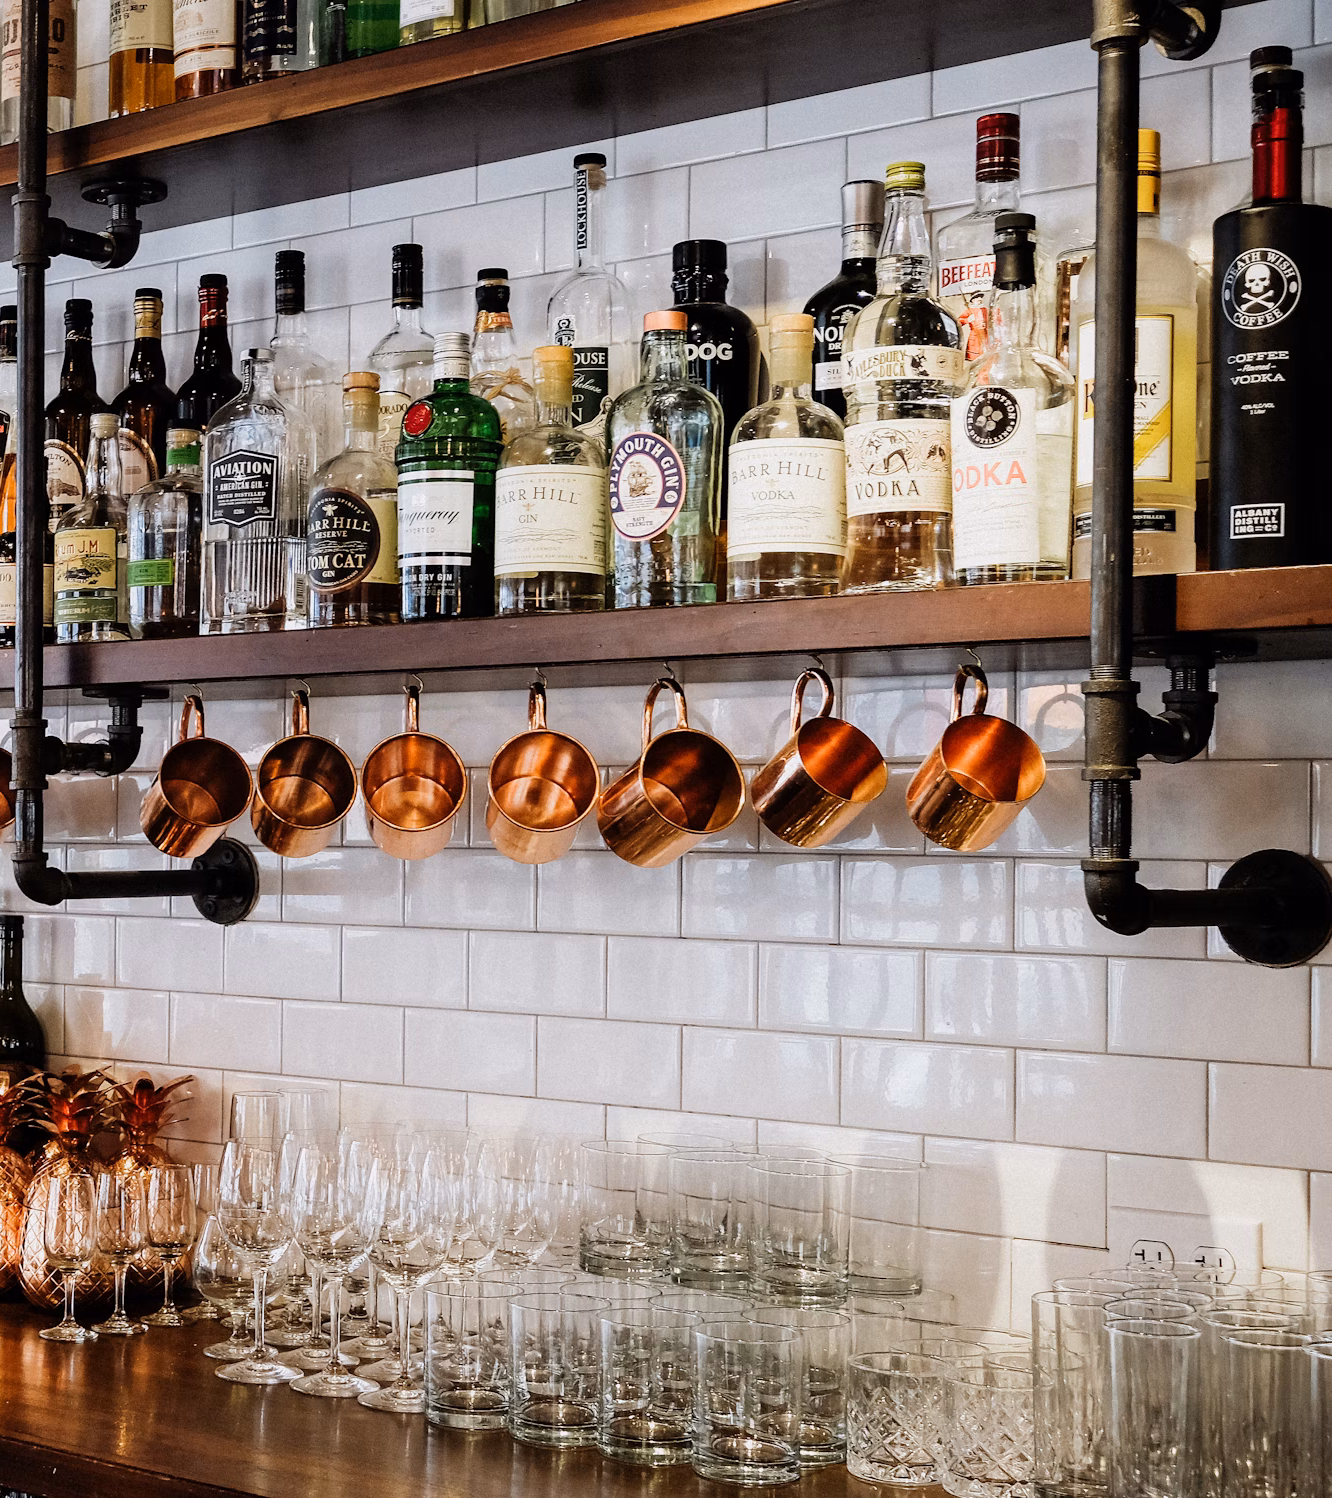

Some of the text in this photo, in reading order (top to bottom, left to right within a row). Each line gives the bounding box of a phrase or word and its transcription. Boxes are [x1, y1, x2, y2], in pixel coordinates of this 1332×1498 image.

[577, 170, 587, 250] LOCKHOUSE
[1225, 250, 1295, 285] DEATH WISH
[1232, 307, 1284, 327] COFFEE
[828, 342, 841, 351] DR
[1226, 350, 1289, 364] COFFEE
[879, 360, 907, 377] DUCK
[1230, 373, 1286, 386] VODKA
[967, 392, 1016, 424] BLACK BUTTON
[969, 425, 1013, 445] DISTILLING
[48, 453, 72, 466] ILTON
[609, 438, 680, 494] PLYMOUTH GIN
[213, 461, 272, 479] AVIATION
[731, 460, 825, 485] BARR HILL
[954, 460, 1027, 492] ODKA
[220, 481, 250, 491] AMERICAN
[855, 479, 921, 501] VODKA
[496, 486, 578, 507] BARR HILL
[751, 490, 795, 501] VODKA
[399, 507, 460, 527] nqueray
[519, 513, 538, 524] GIN
[1234, 508, 1279, 518] ALBANY
[332, 516, 371, 533] HILL
[1234, 517, 1279, 526] DISTILL
[315, 530, 348, 540] RESERVE
[404, 526, 435, 534] MPORTED
[1234, 525, 1255, 534] ING
[332, 553, 366, 568] CAT
[322, 570, 336, 578] GIN
[418, 573, 435, 581] DRY
[437, 573, 453, 581] GIN
